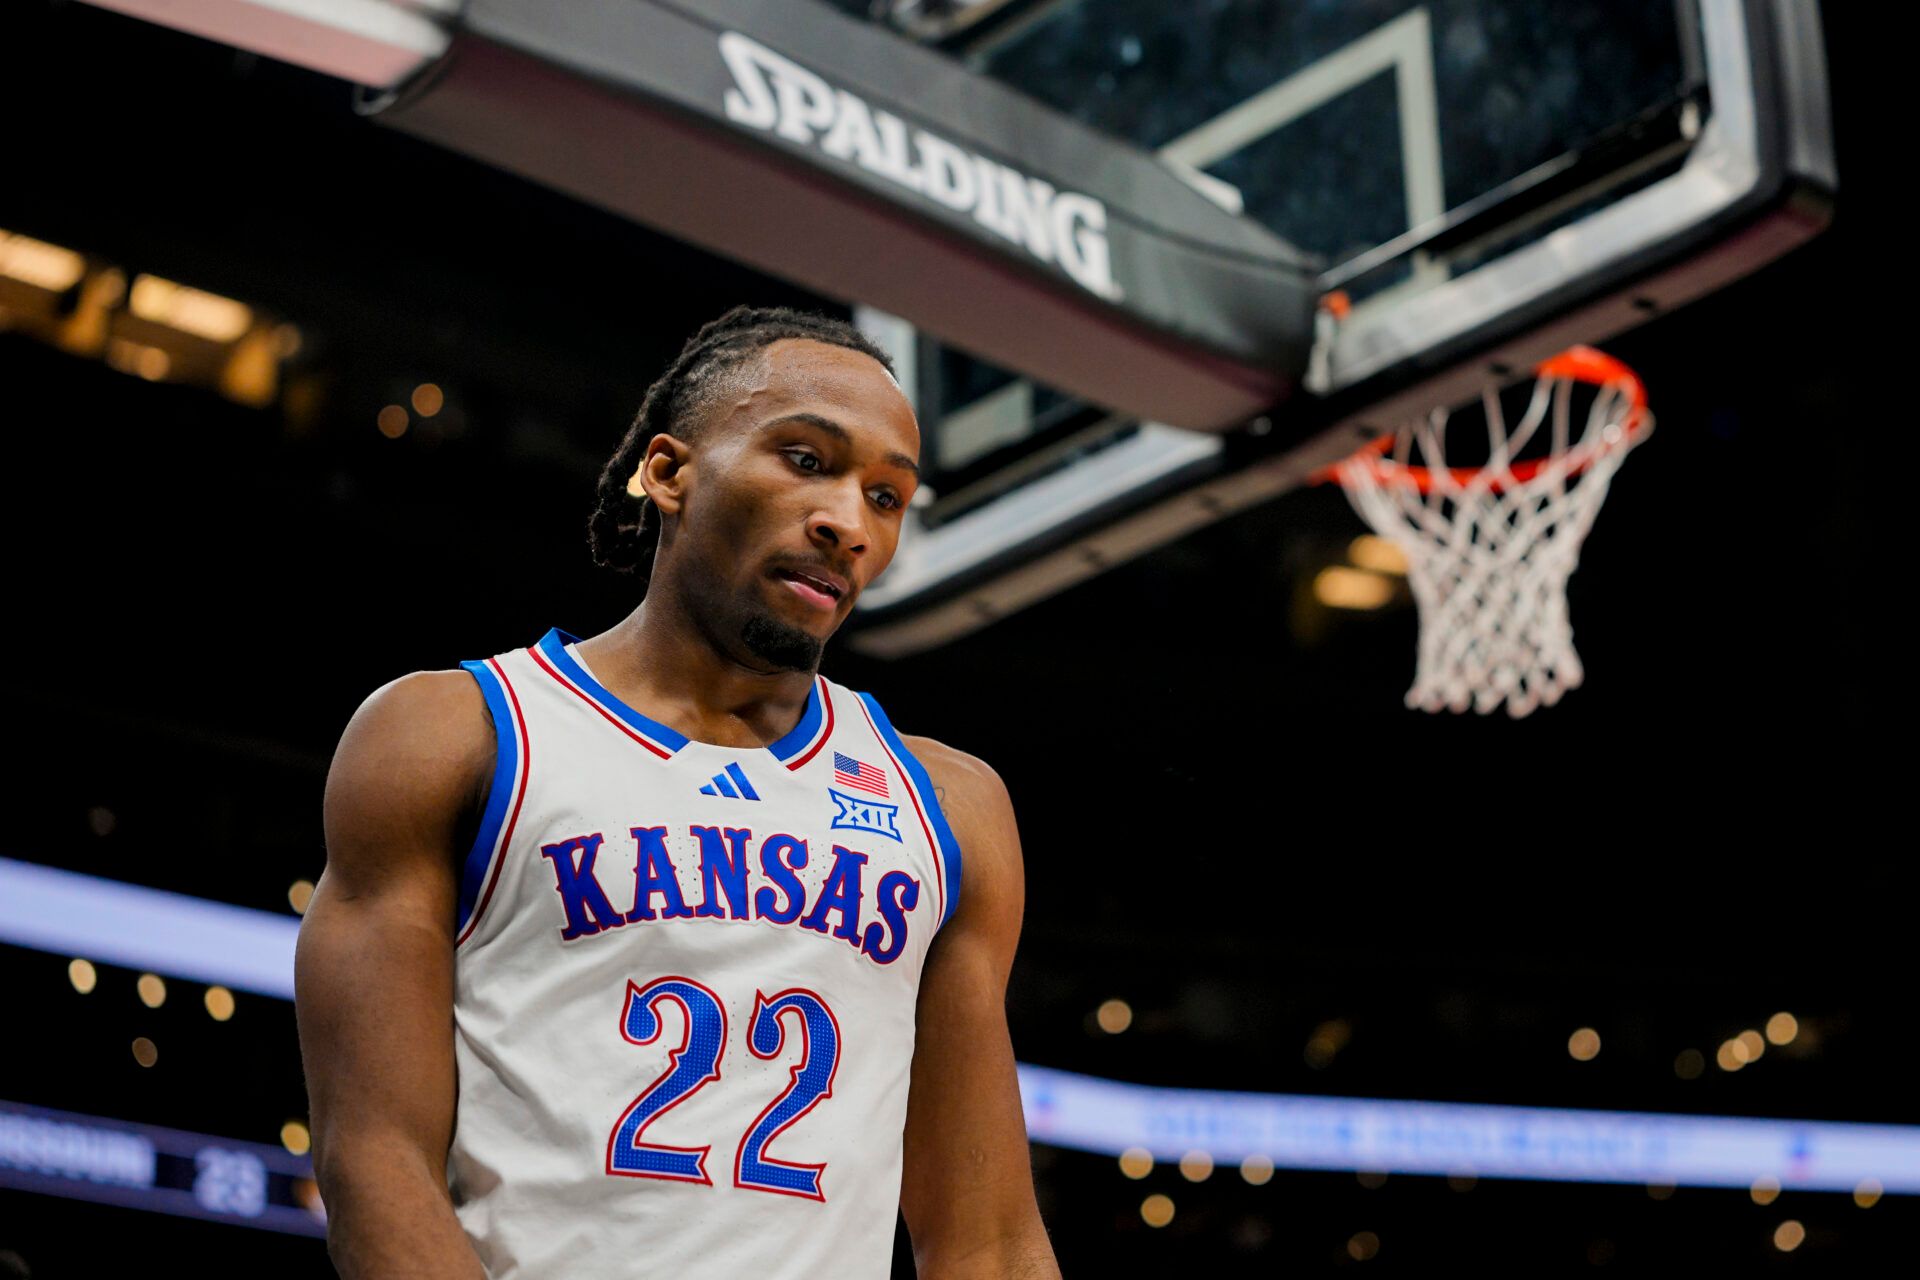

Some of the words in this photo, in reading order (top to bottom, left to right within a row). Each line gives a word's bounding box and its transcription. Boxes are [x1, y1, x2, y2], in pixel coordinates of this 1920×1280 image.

[718, 31, 1123, 302] SPALDING
[541, 825, 920, 965] KANSAS
[605, 975, 842, 1203] 22
